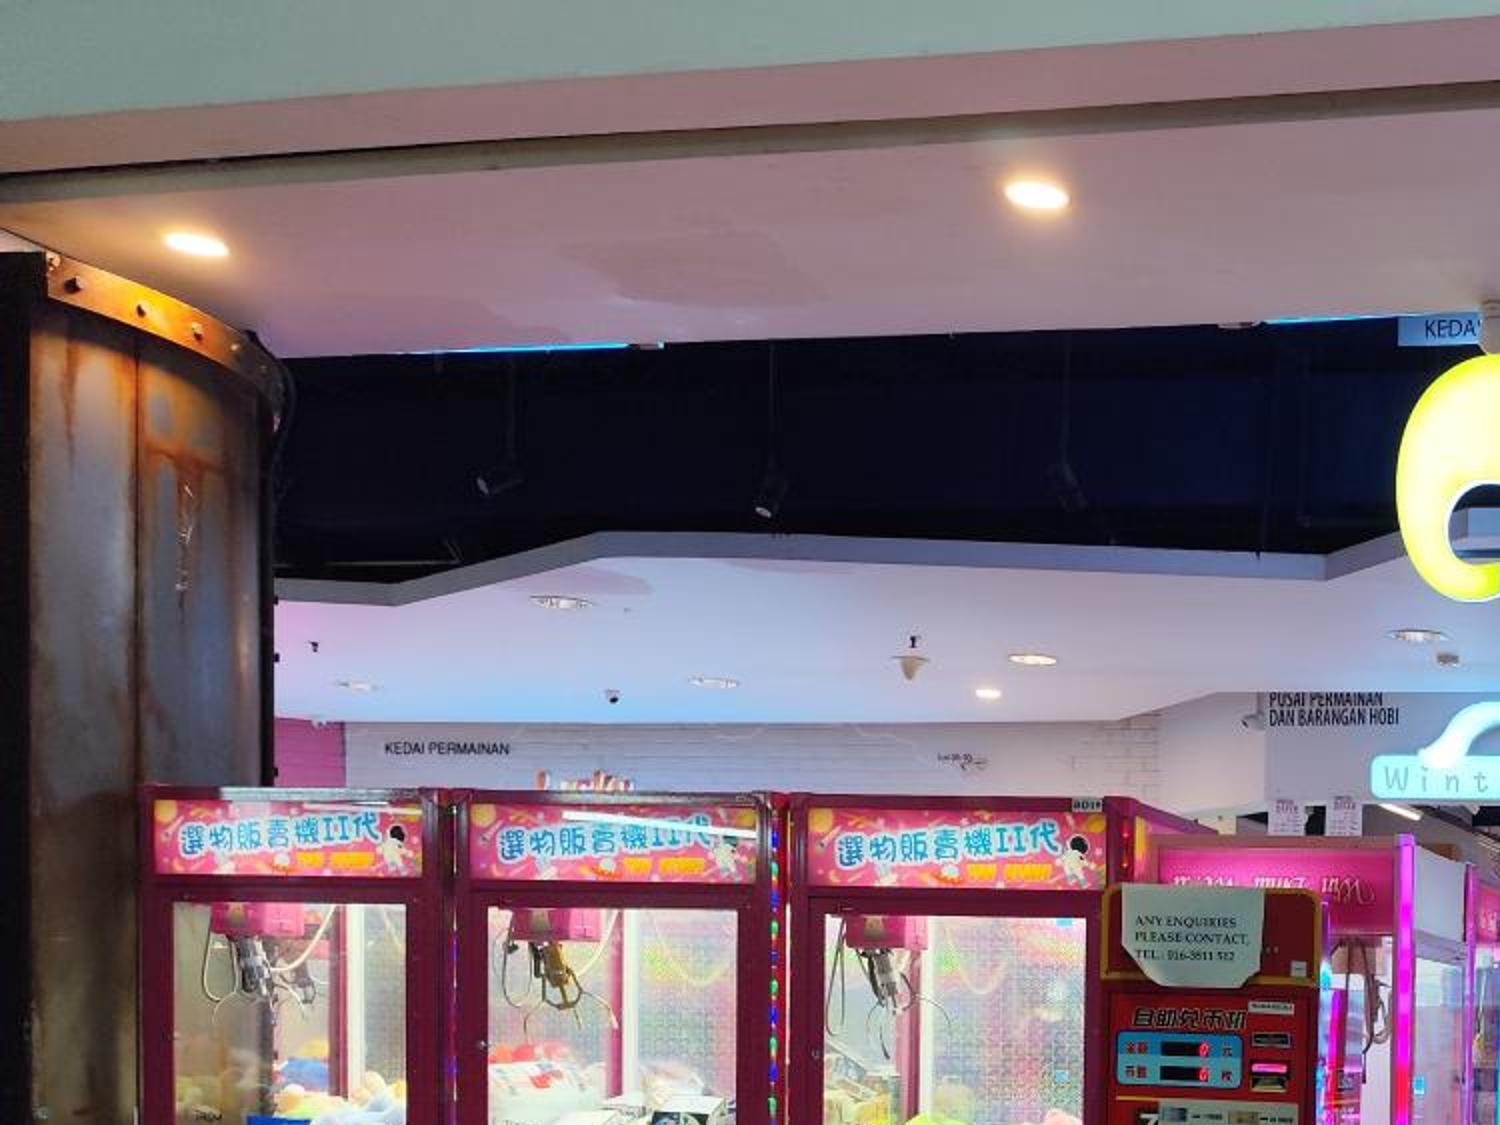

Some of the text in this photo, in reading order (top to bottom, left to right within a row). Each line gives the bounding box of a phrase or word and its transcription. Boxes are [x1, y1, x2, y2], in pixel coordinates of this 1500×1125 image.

[1424, 319, 1482, 339] KEDA
[1269, 707, 1399, 726] DAN BARANGAN HOBI
[384, 742, 511, 756] KEDAI PERMAINAN
[1135, 915, 1237, 929] ANY ENQUIRIES
[1135, 931, 1183, 943] PLEASE
